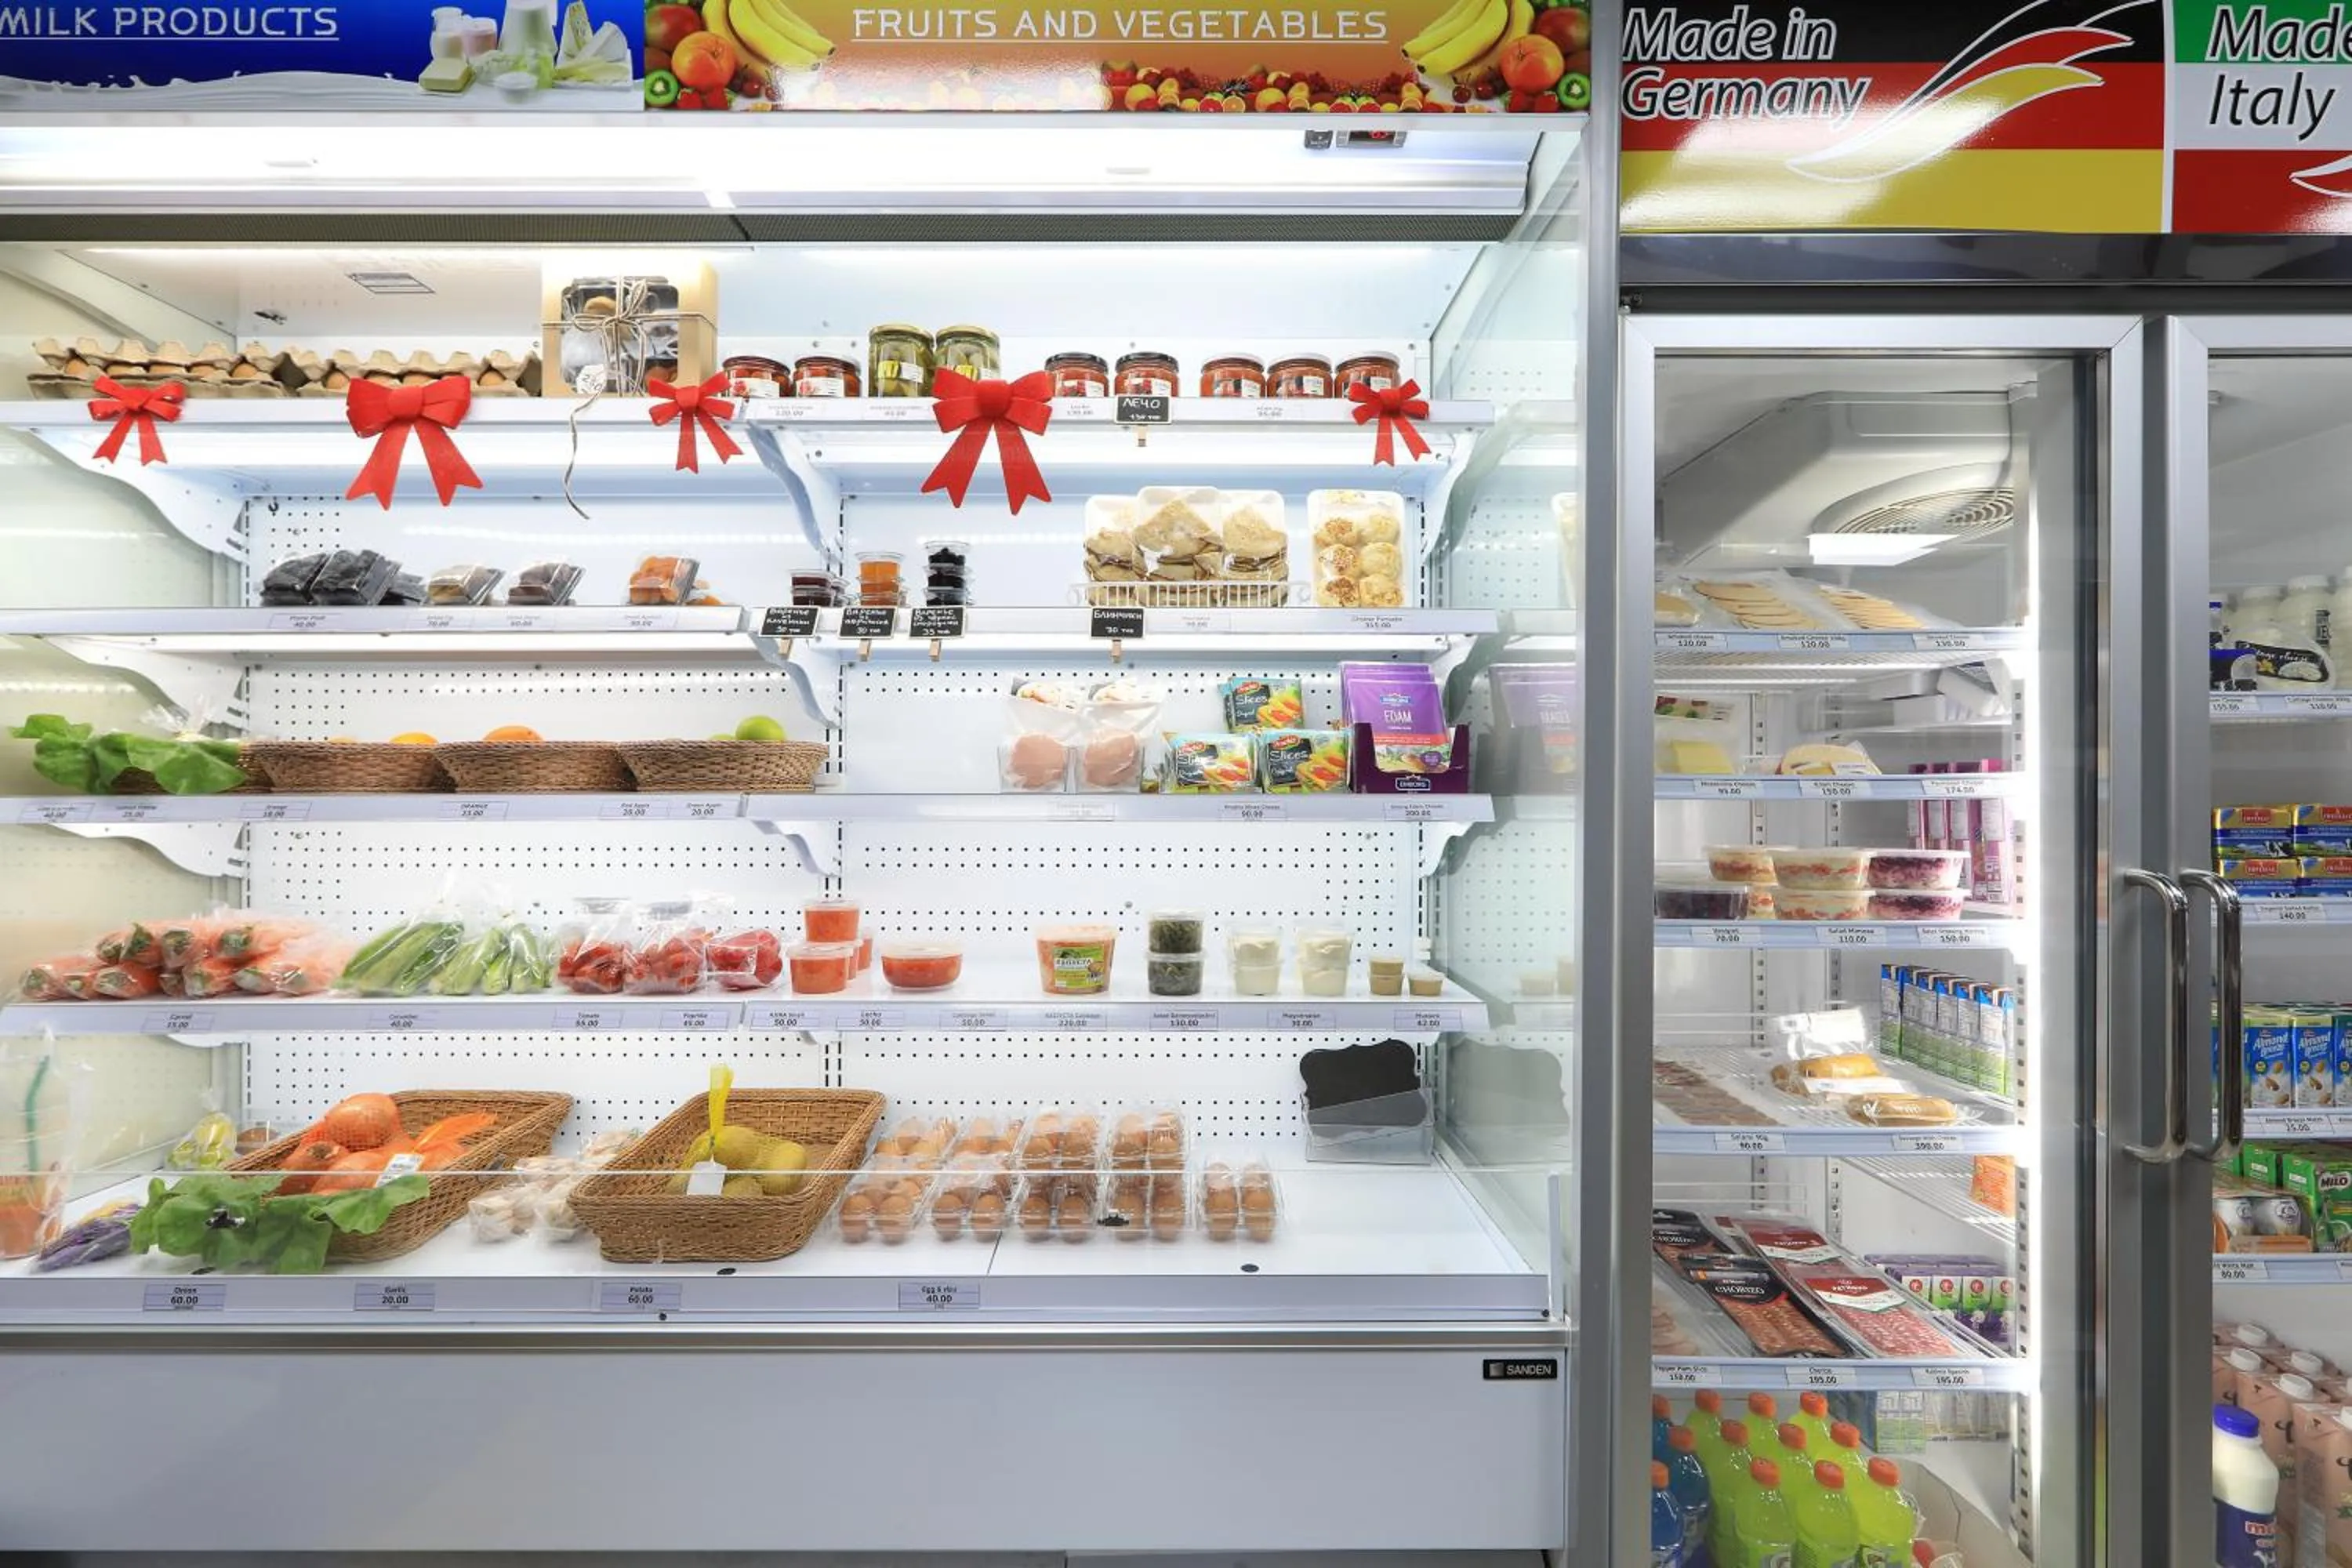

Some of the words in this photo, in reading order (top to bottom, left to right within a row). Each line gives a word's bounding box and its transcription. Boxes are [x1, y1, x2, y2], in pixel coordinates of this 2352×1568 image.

[0, 7, 97, 35] MILK
[113, 6, 339, 36] PRODUCTS
[853, 9, 997, 38] FRUITS
[1014, 10, 1098, 38] AND
[1115, 10, 1387, 38] VEGETABLES
[1623, 5, 1777, 61] Made
[1782, 7, 1837, 60] in
[1621, 66, 1871, 130] Germany
[2209, 71, 2336, 142] Italy
[1235, 695, 1268, 706] Slices
[1384, 710, 1414, 724] EDAM
[1269, 750, 1309, 762] Slices
[2252, 1031, 2289, 1051] Almond
[2298, 1030, 2332, 1051] Almond
[2319, 1176, 2350, 1188] MILO
[921, 1286, 935, 1294] Egg
[169, 1295, 198, 1305] 60.00
[382, 1295, 409, 1304] 20.00
[627, 1294, 654, 1304] 60.00
[926, 1294, 953, 1303] 40.00
[1506, 1364, 1552, 1376] SANDEN
